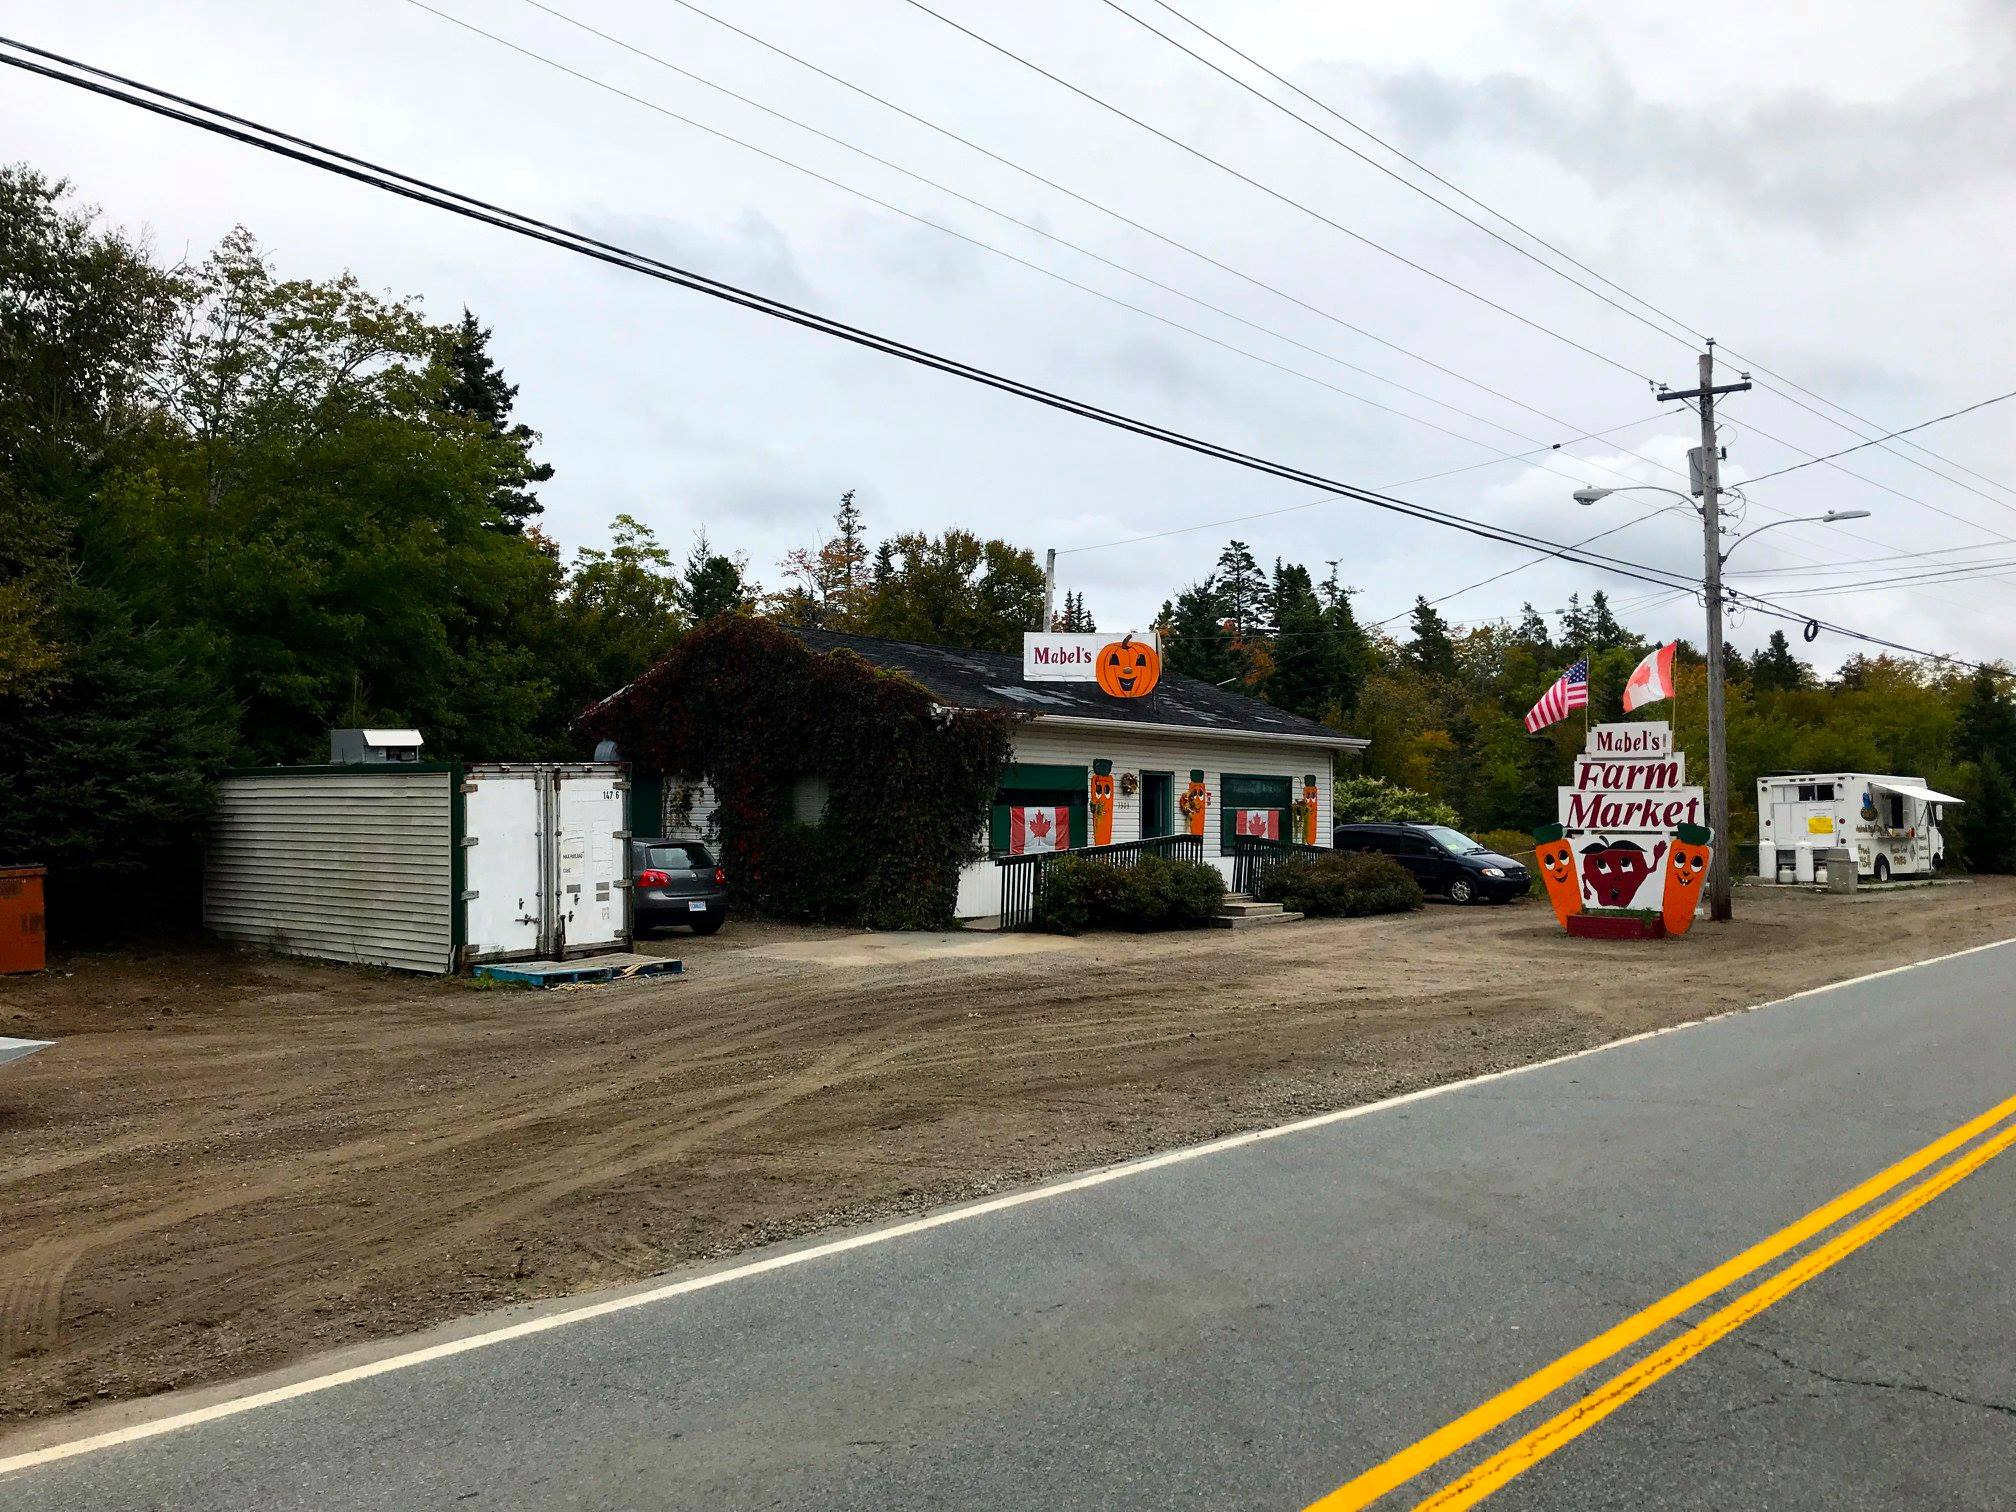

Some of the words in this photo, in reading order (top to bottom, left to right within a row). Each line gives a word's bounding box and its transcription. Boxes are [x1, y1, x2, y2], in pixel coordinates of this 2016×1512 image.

[1034, 646, 1092, 664] Mabel's
[1597, 730, 1660, 752] Mabel's
[1578, 762, 1679, 790] Farm
[1565, 793, 1699, 828] Market
